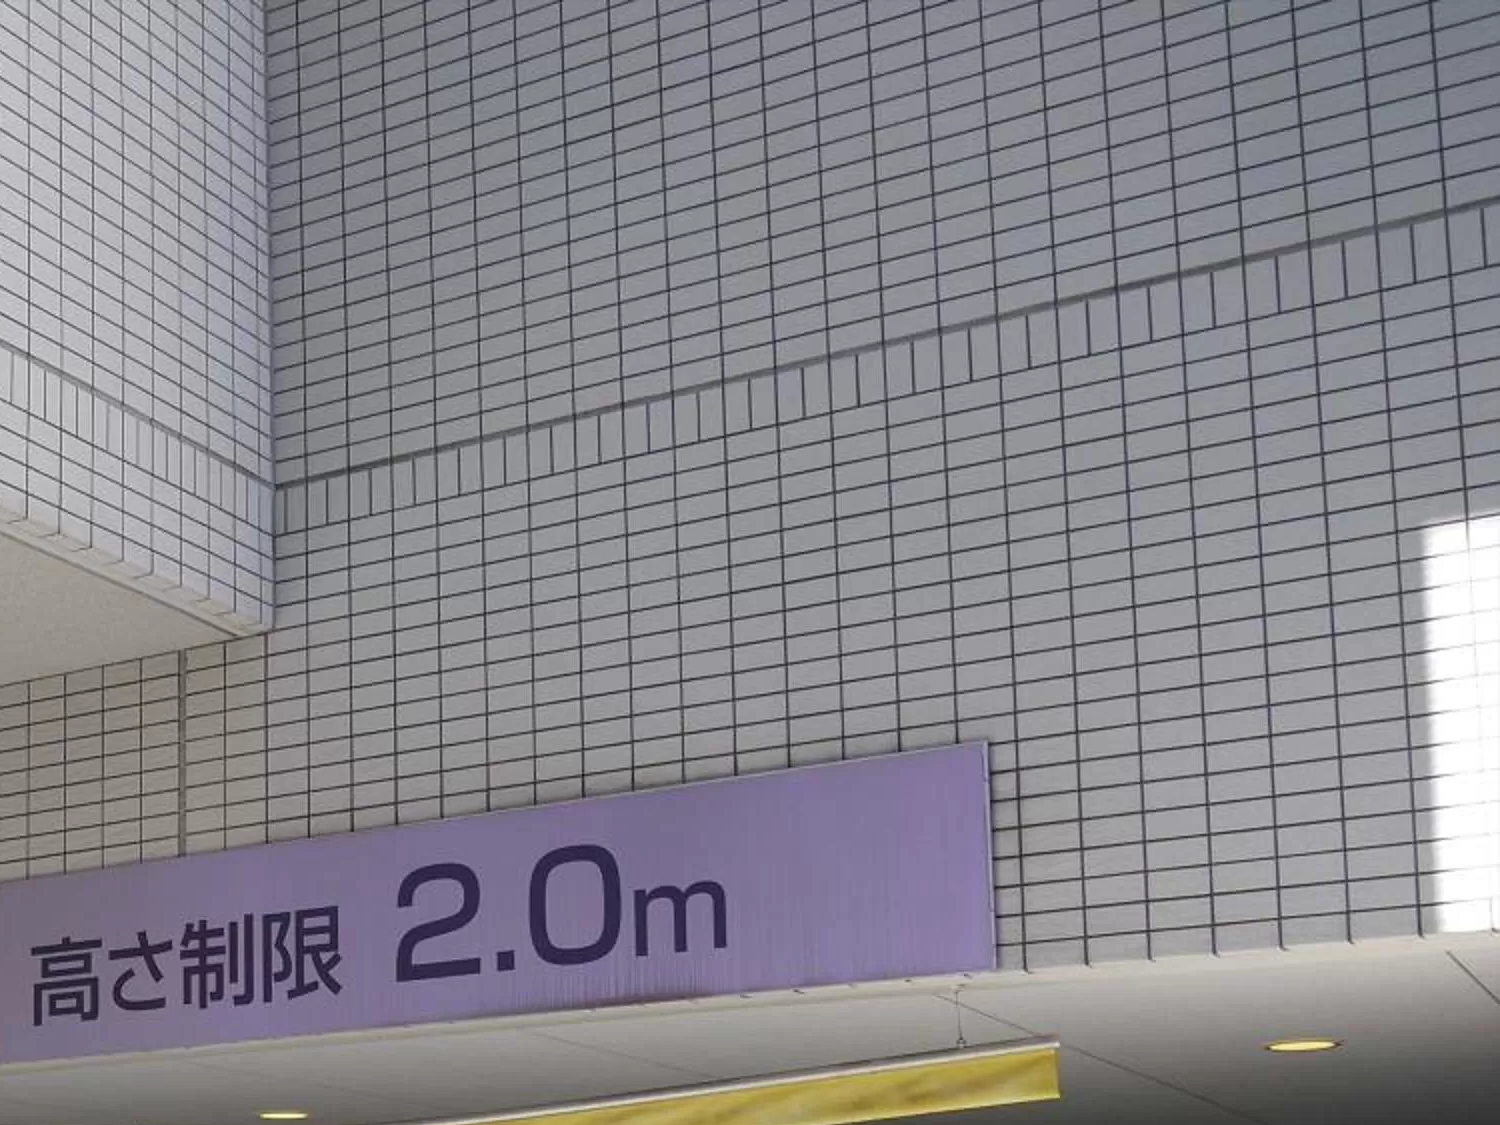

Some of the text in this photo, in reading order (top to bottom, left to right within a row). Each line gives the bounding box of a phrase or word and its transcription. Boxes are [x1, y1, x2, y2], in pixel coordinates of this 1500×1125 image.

[30, 843, 728, 1027] 高さ制限 2.0m
